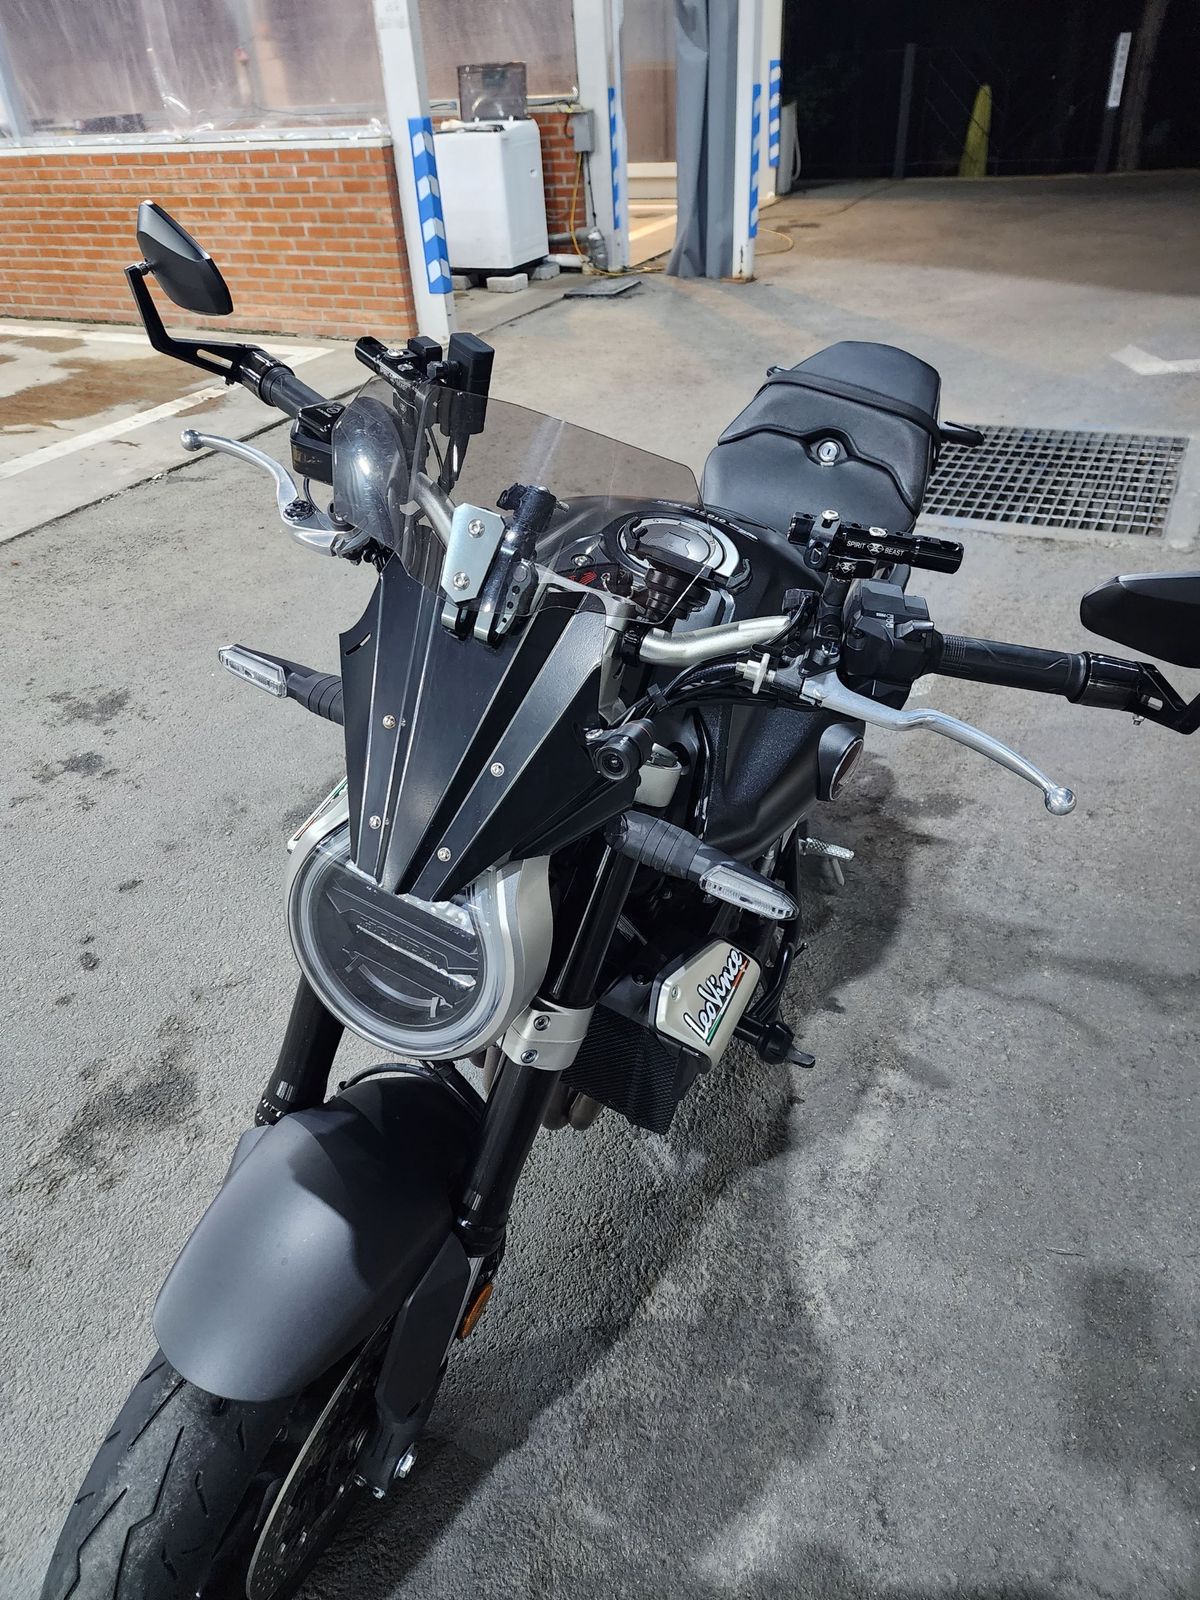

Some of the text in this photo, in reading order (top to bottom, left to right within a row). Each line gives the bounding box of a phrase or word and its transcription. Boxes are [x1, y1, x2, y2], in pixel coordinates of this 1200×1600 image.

[846, 540, 904, 557] SPIRIT BEAST
[683, 948, 743, 1042] LeoVince
